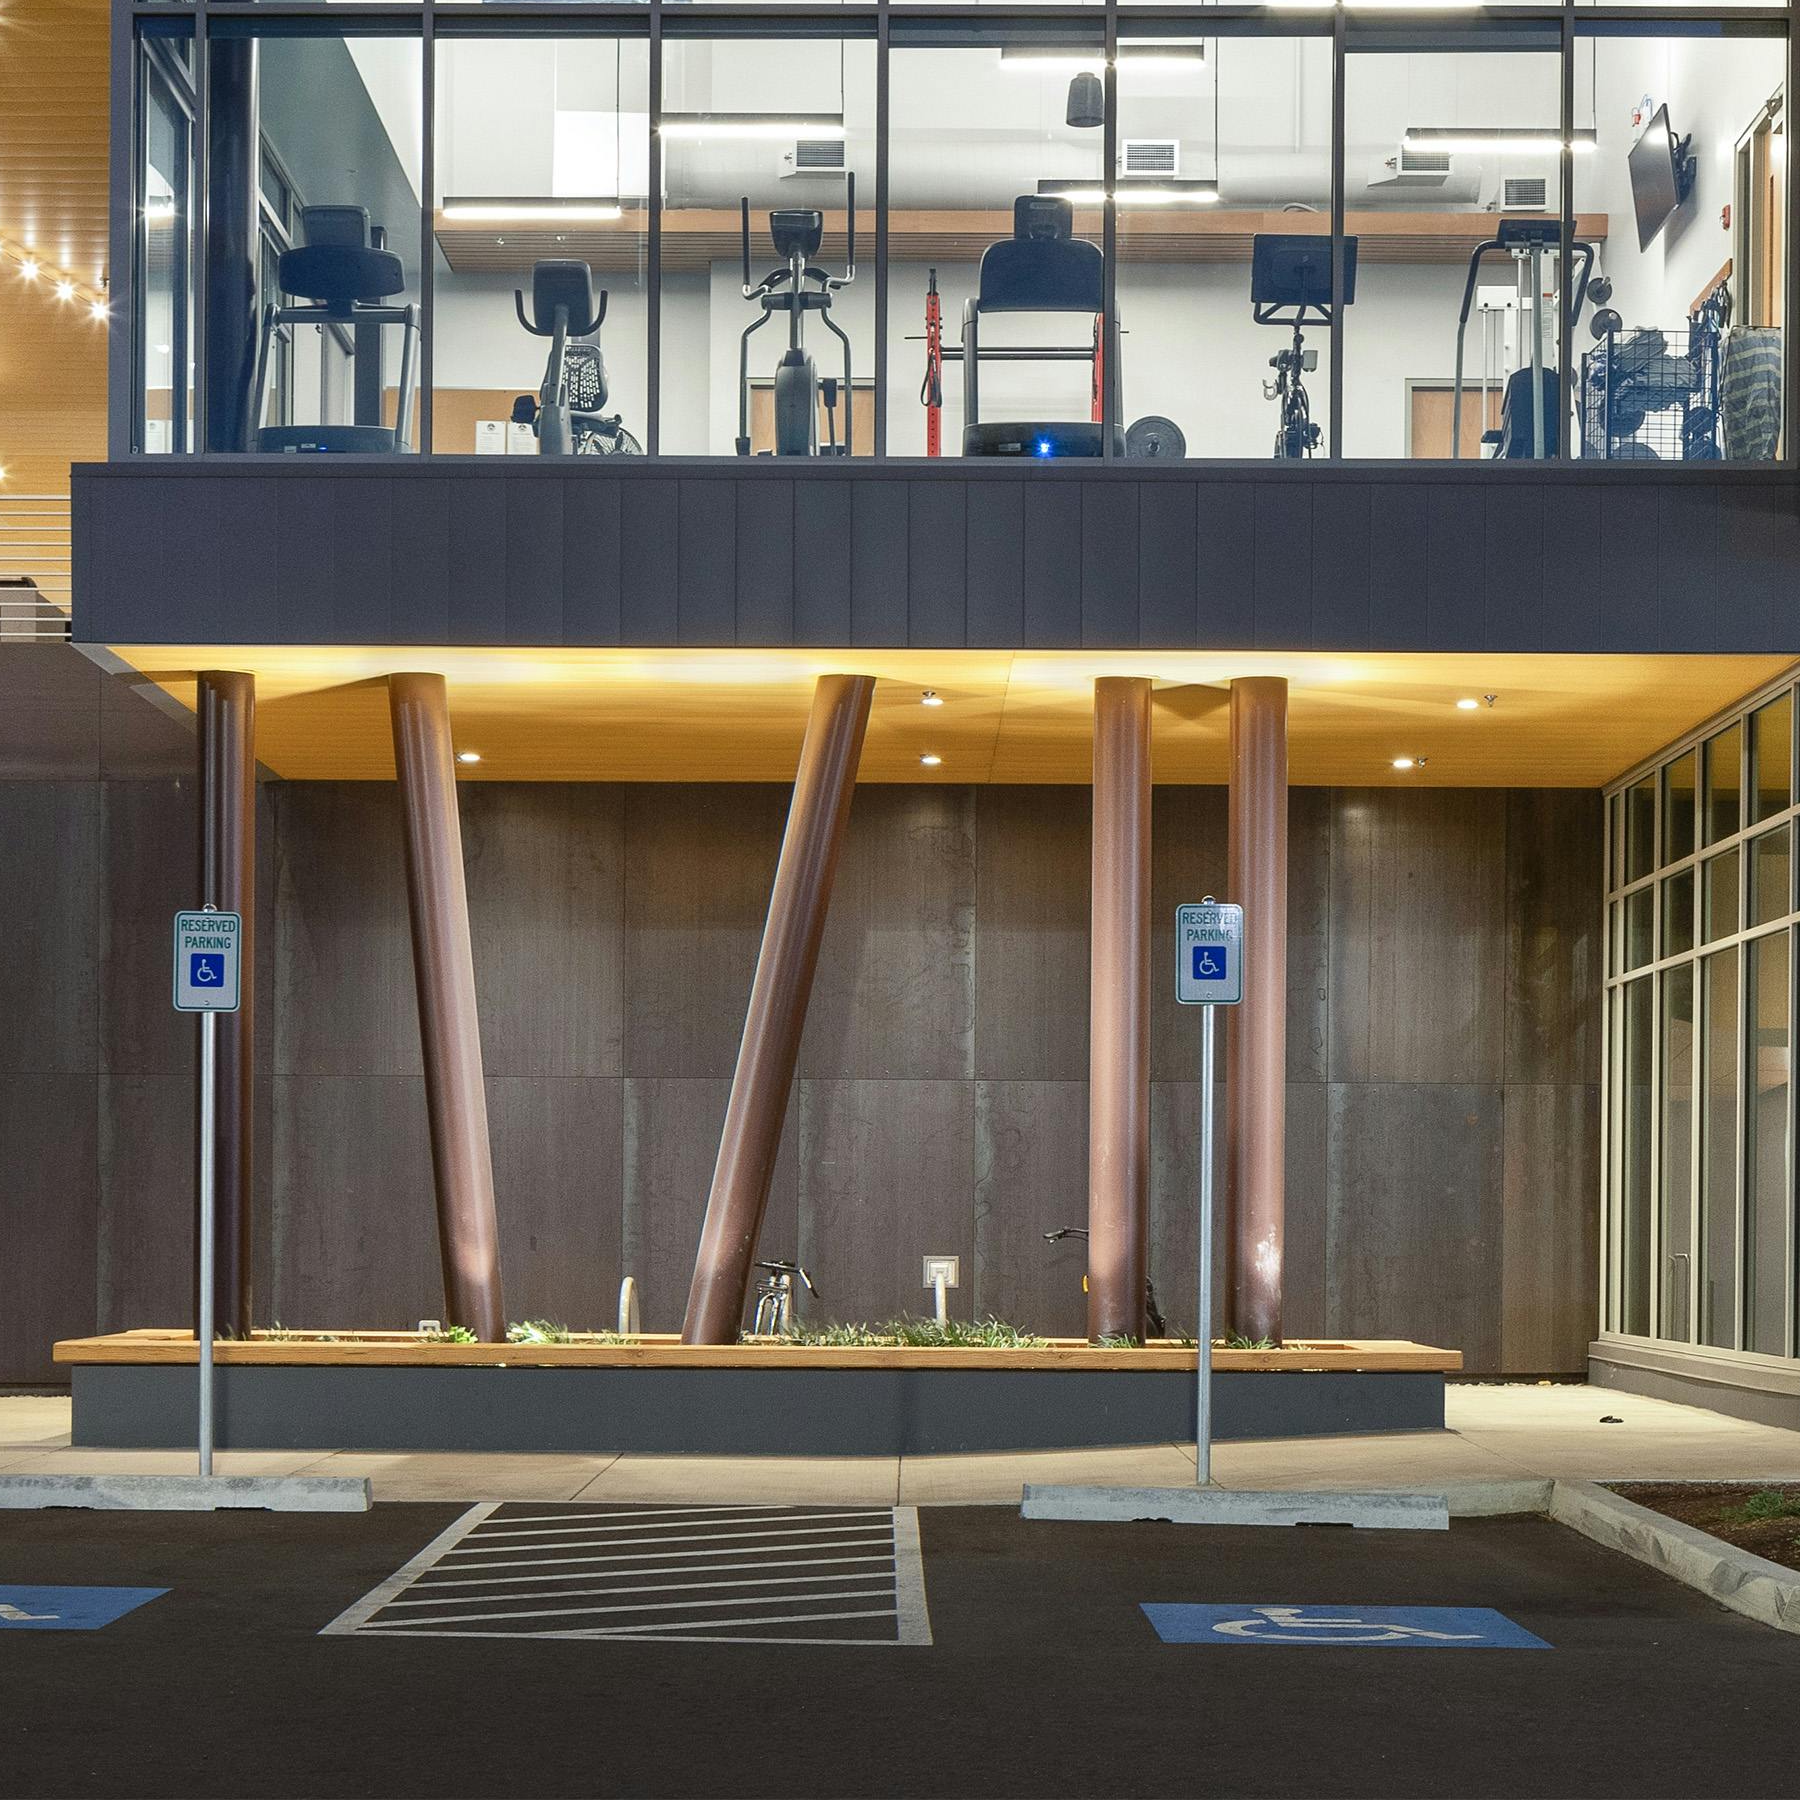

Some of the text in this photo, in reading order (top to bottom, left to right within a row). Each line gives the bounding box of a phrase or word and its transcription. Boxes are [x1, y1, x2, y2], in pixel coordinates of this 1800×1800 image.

[181, 919, 236, 933] RESERVED
[184, 935, 232, 949] PARKING
[1186, 929, 1233, 942] PARKING
